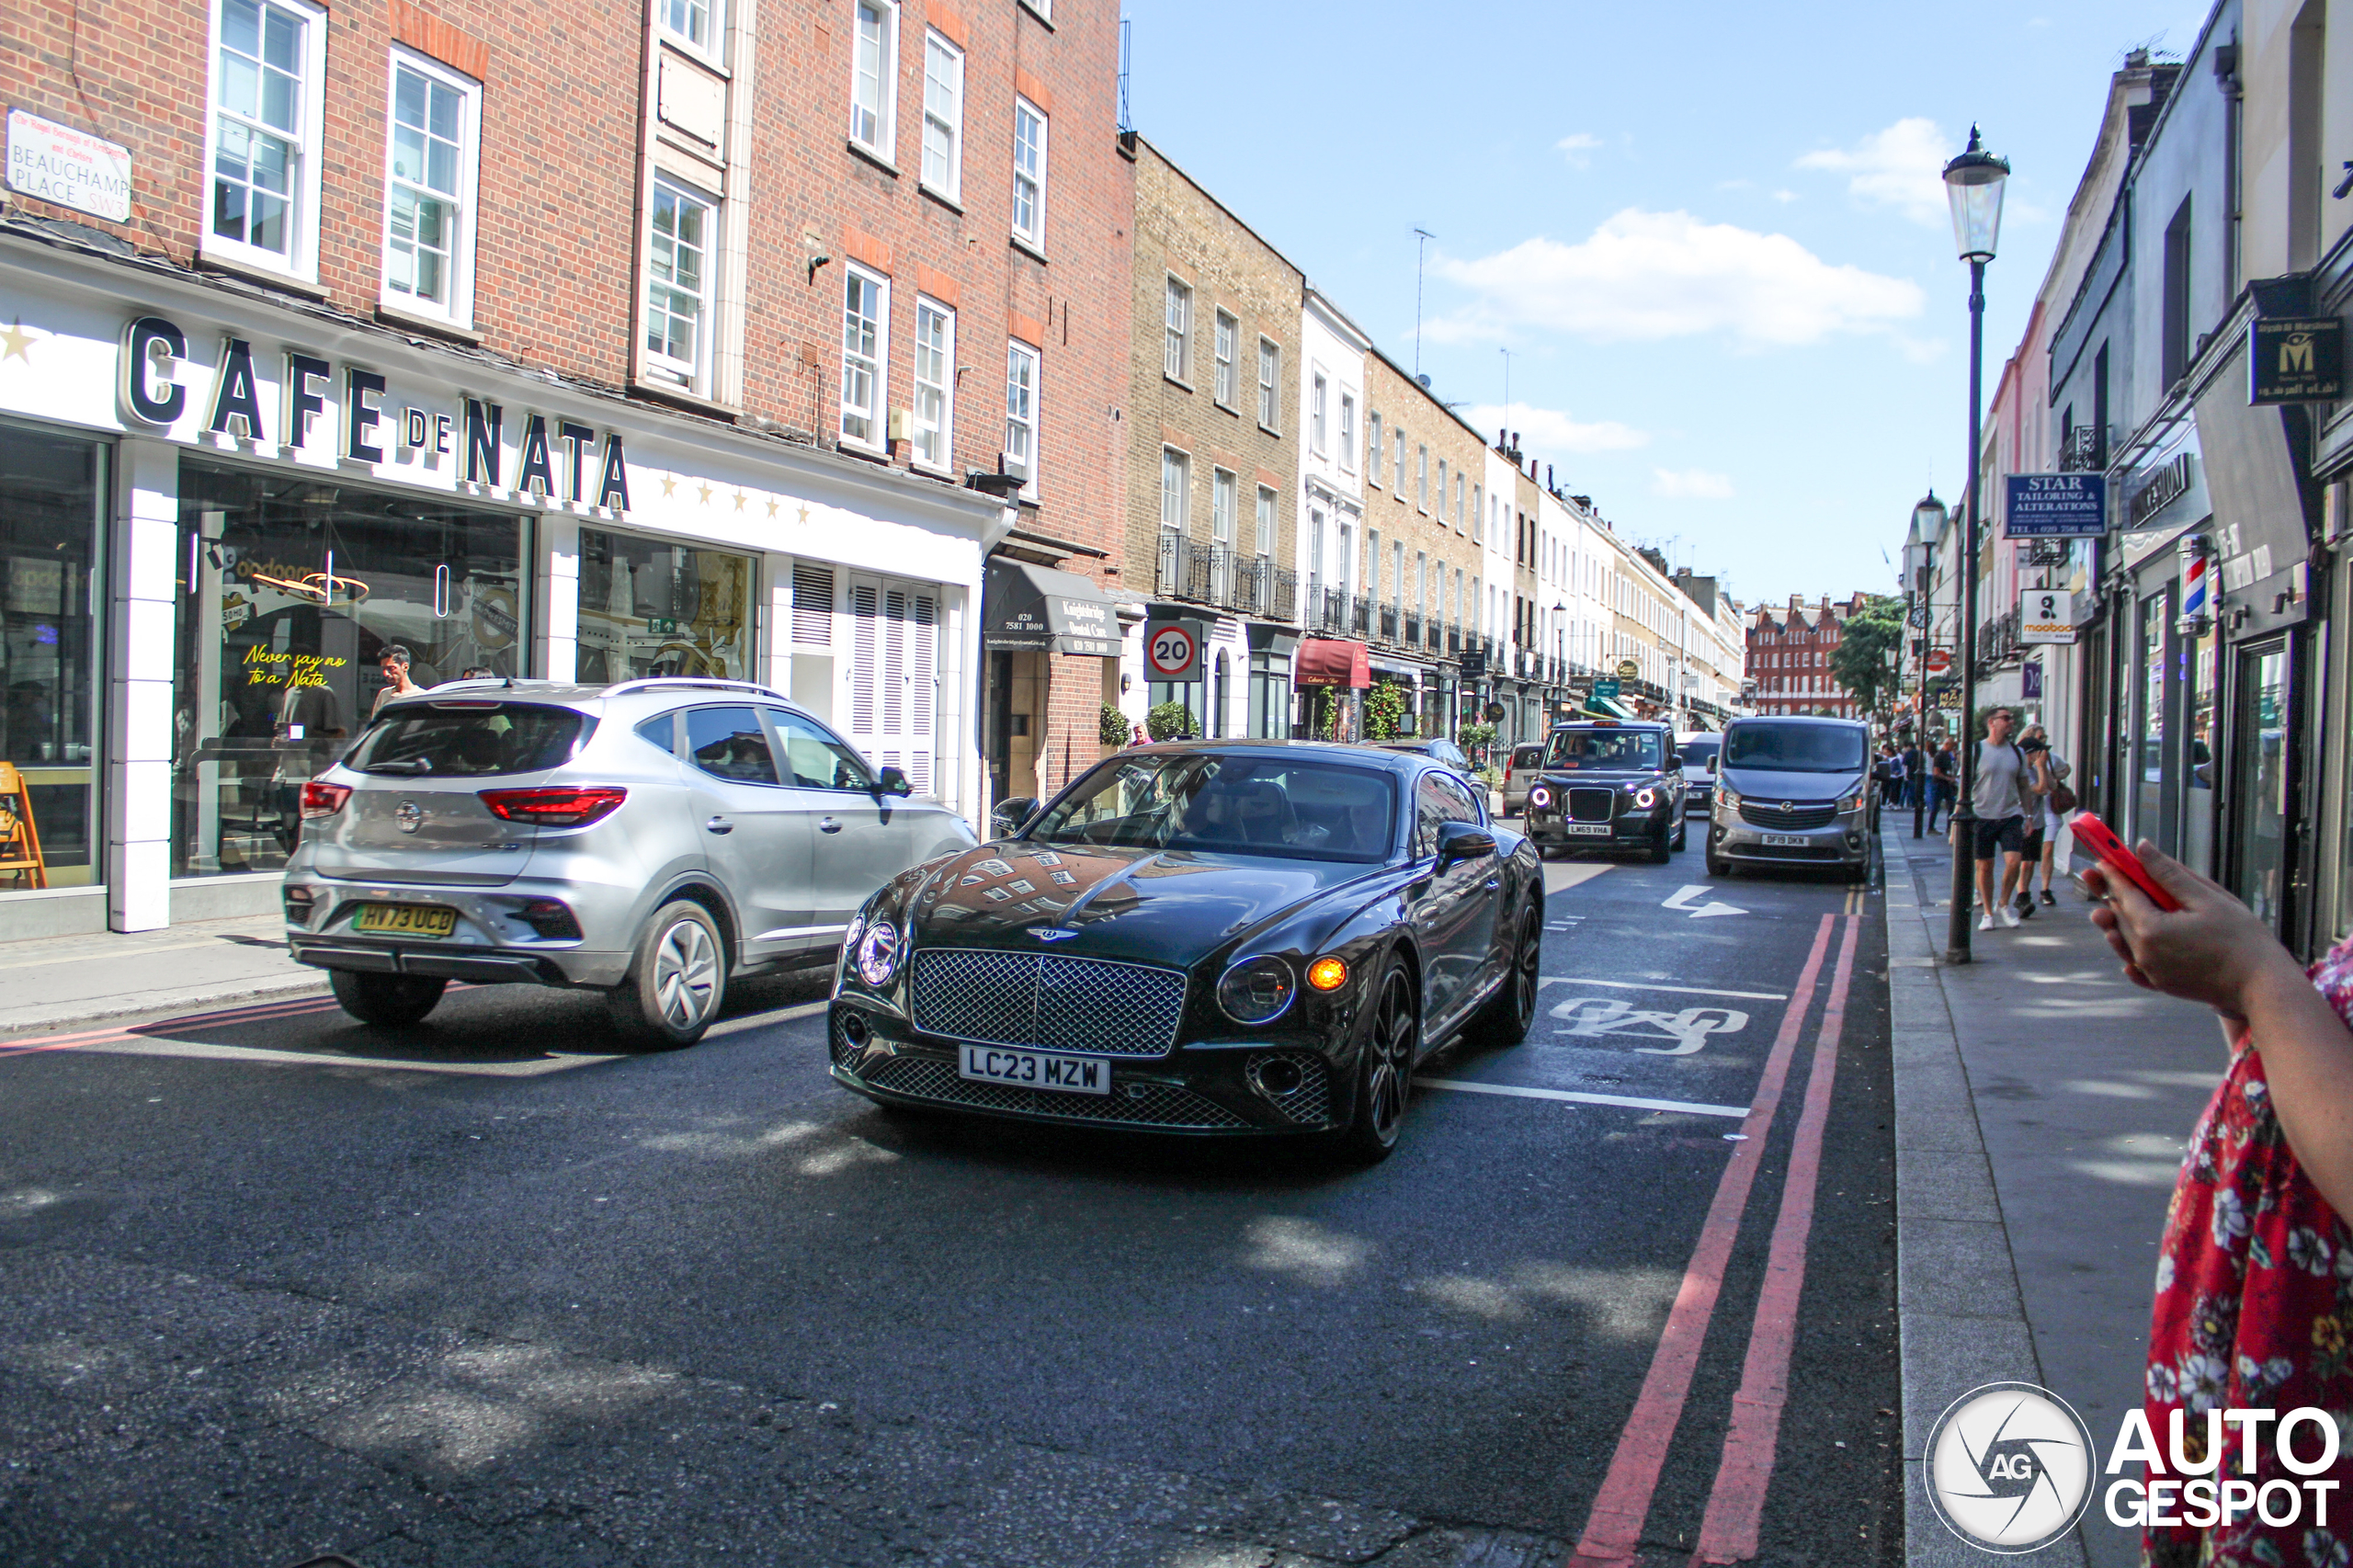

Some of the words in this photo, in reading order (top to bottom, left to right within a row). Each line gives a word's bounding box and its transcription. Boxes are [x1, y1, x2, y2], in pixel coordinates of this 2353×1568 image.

[30, 119, 51, 135] Royal
[53, 127, 81, 145] Borough
[84, 139, 91, 147] of
[51, 144, 64, 154] and
[66, 148, 93, 164] Chelsea
[13, 145, 129, 198] BEAUCHAMP
[119, 315, 386, 464] CAFE
[399, 406, 452, 455] DE
[460, 396, 631, 513] NATA
[2029, 477, 2084, 491] STAR
[2016, 492, 2084, 501] TAILORING
[2086, 492, 2096, 500] &
[2015, 502, 2098, 512] ALTERATIONS
[2009, 525, 2031, 533] TEL
[2040, 525, 2058, 533] 020
[222, 608, 243, 620] SOHO
[472, 603, 517, 634] HAMMERSMIT
[1018, 613, 1031, 621] 020
[1063, 600, 1106, 622] Knightsbridge
[1006, 622, 1022, 631] 7581
[1026, 622, 1043, 631] 1000
[1069, 621, 1089, 636] Dental
[1090, 624, 1107, 638] Care
[1074, 640, 1083, 651] 020
[1084, 641, 1096, 652] 7581
[1097, 642, 1108, 653] 1000
[1156, 641, 1187, 660] 20
[243, 644, 291, 665] Never
[294, 654, 324, 671] say
[324, 655, 347, 668] no
[248, 667, 266, 685] to
[266, 675, 282, 685] a
[285, 668, 328, 688] Nata
[1571, 825, 1591, 834] LM69
[1593, 825, 1608, 834] VHA
[1767, 835, 1786, 844] DF19
[970, 1049, 1037, 1082] LC23
[1044, 1058, 1098, 1088] MZW
